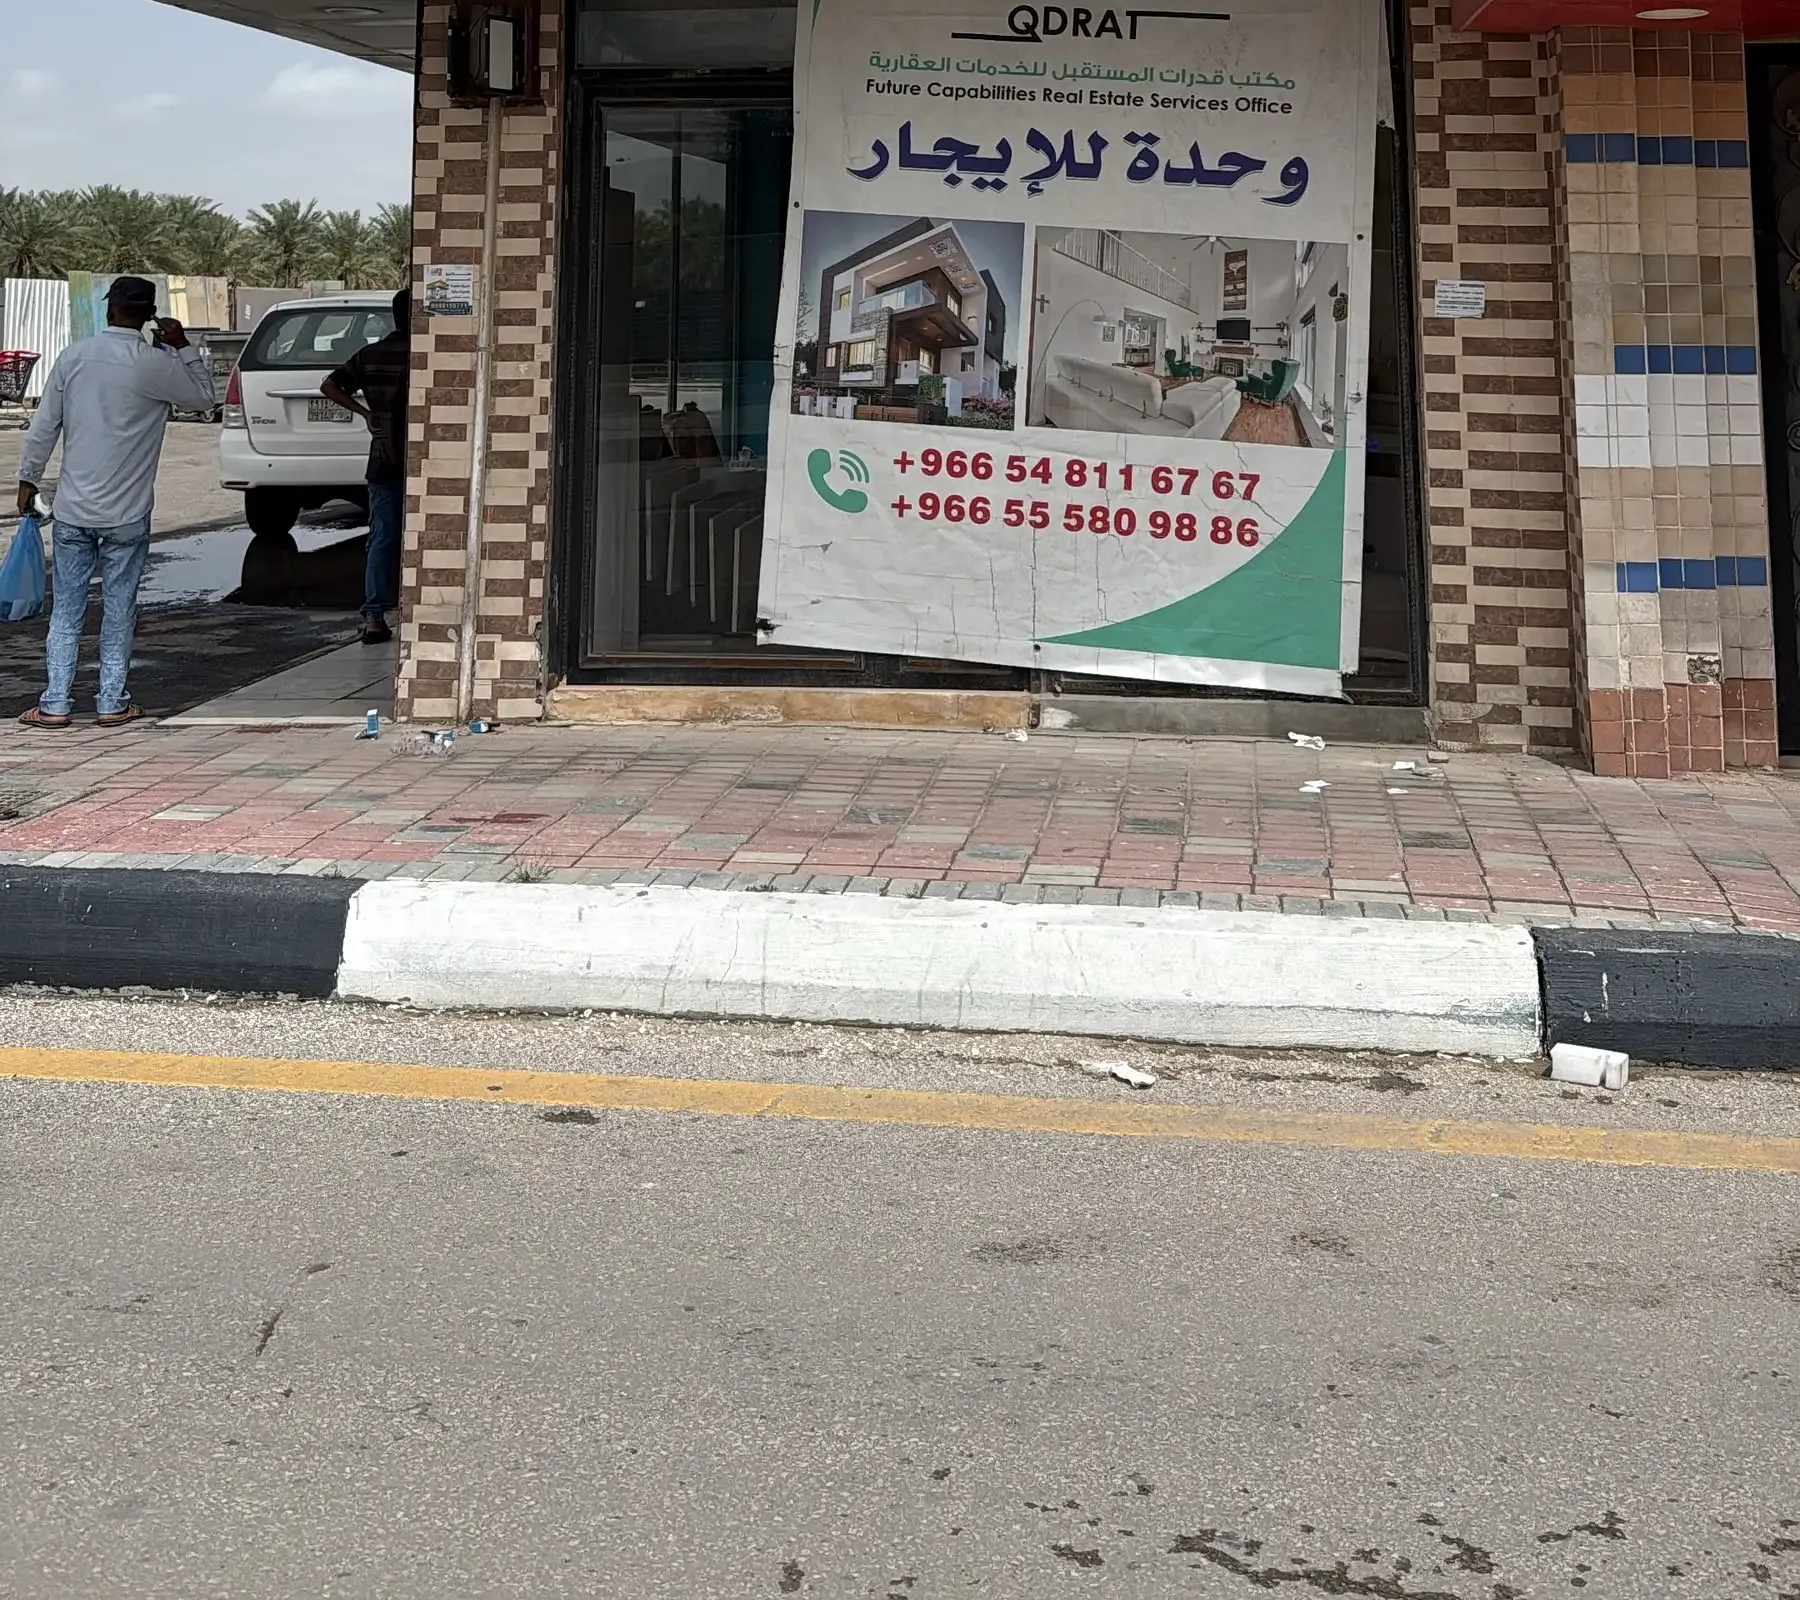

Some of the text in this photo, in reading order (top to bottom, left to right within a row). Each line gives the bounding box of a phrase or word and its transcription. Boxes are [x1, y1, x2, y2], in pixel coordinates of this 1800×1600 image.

[866, 78, 1294, 115] Future Capabilities Real Estate Services Office
[868, 50, 1297, 91] مكتب قدرات المستقبل للخدمات العقارية
[845, 119, 1310, 207] وحدة للإيجار
[892, 448, 1260, 500] +966 54 811 67 67
[891, 492, 1259, 547] +966 55 580 98 86
